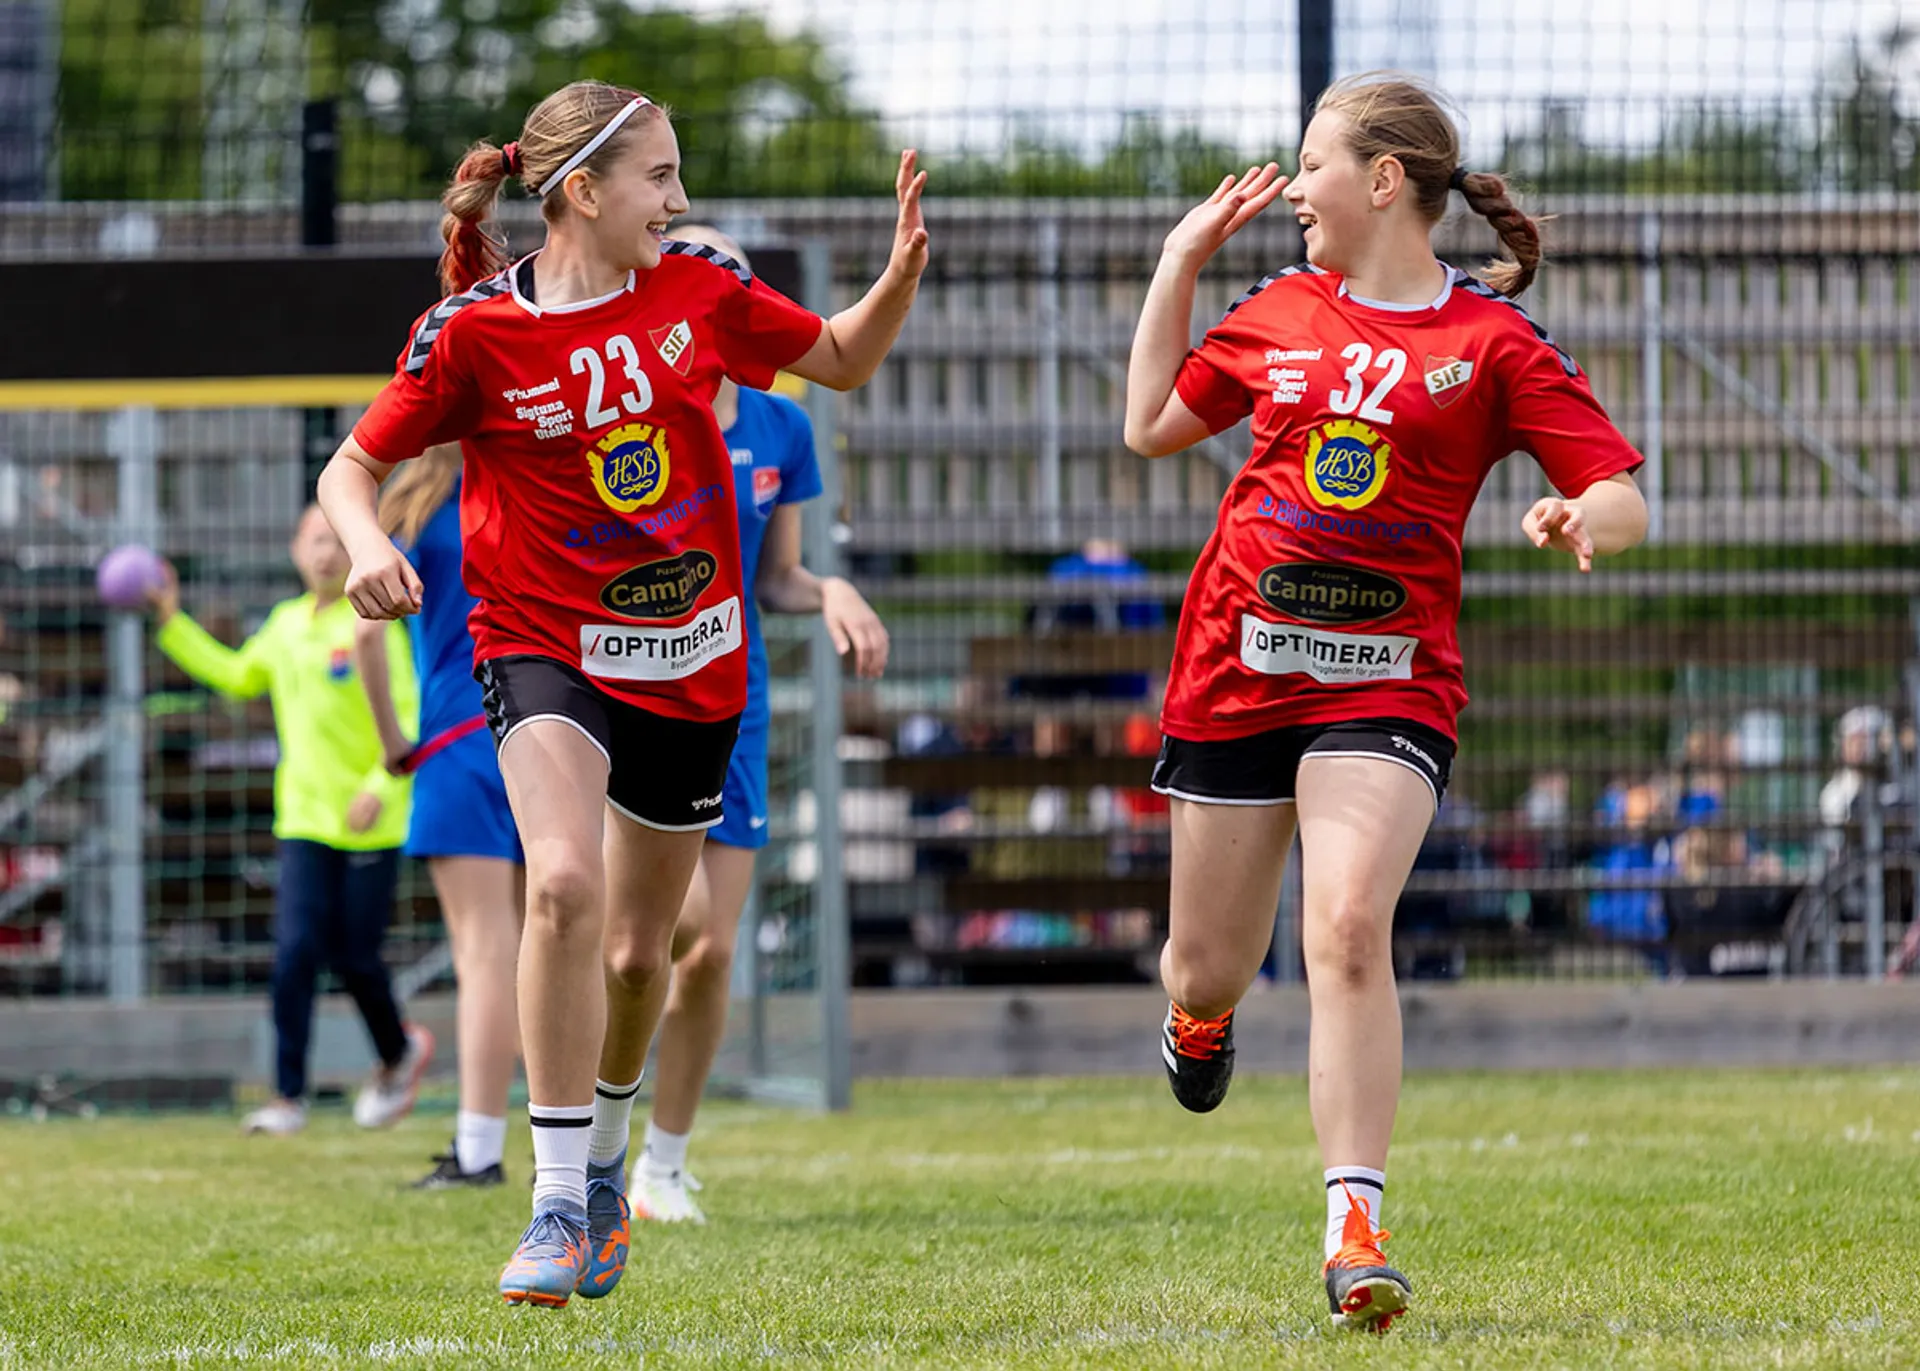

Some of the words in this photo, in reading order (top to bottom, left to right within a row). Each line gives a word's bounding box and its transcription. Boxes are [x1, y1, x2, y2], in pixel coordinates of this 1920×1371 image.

[662, 328, 687, 360] SIF
[516, 376, 560, 400] hummel
[569, 334, 654, 429] 23
[1327, 342, 1408, 425] 32
[1431, 363, 1463, 390] SIF
[515, 400, 565, 420] Sigtuna
[537, 408, 574, 428] Sport
[607, 446, 658, 490] HSB
[1316, 446, 1374, 483] HSB
[1276, 499, 1431, 544] Bilprovningen
[1264, 572, 1397, 610] Campino
